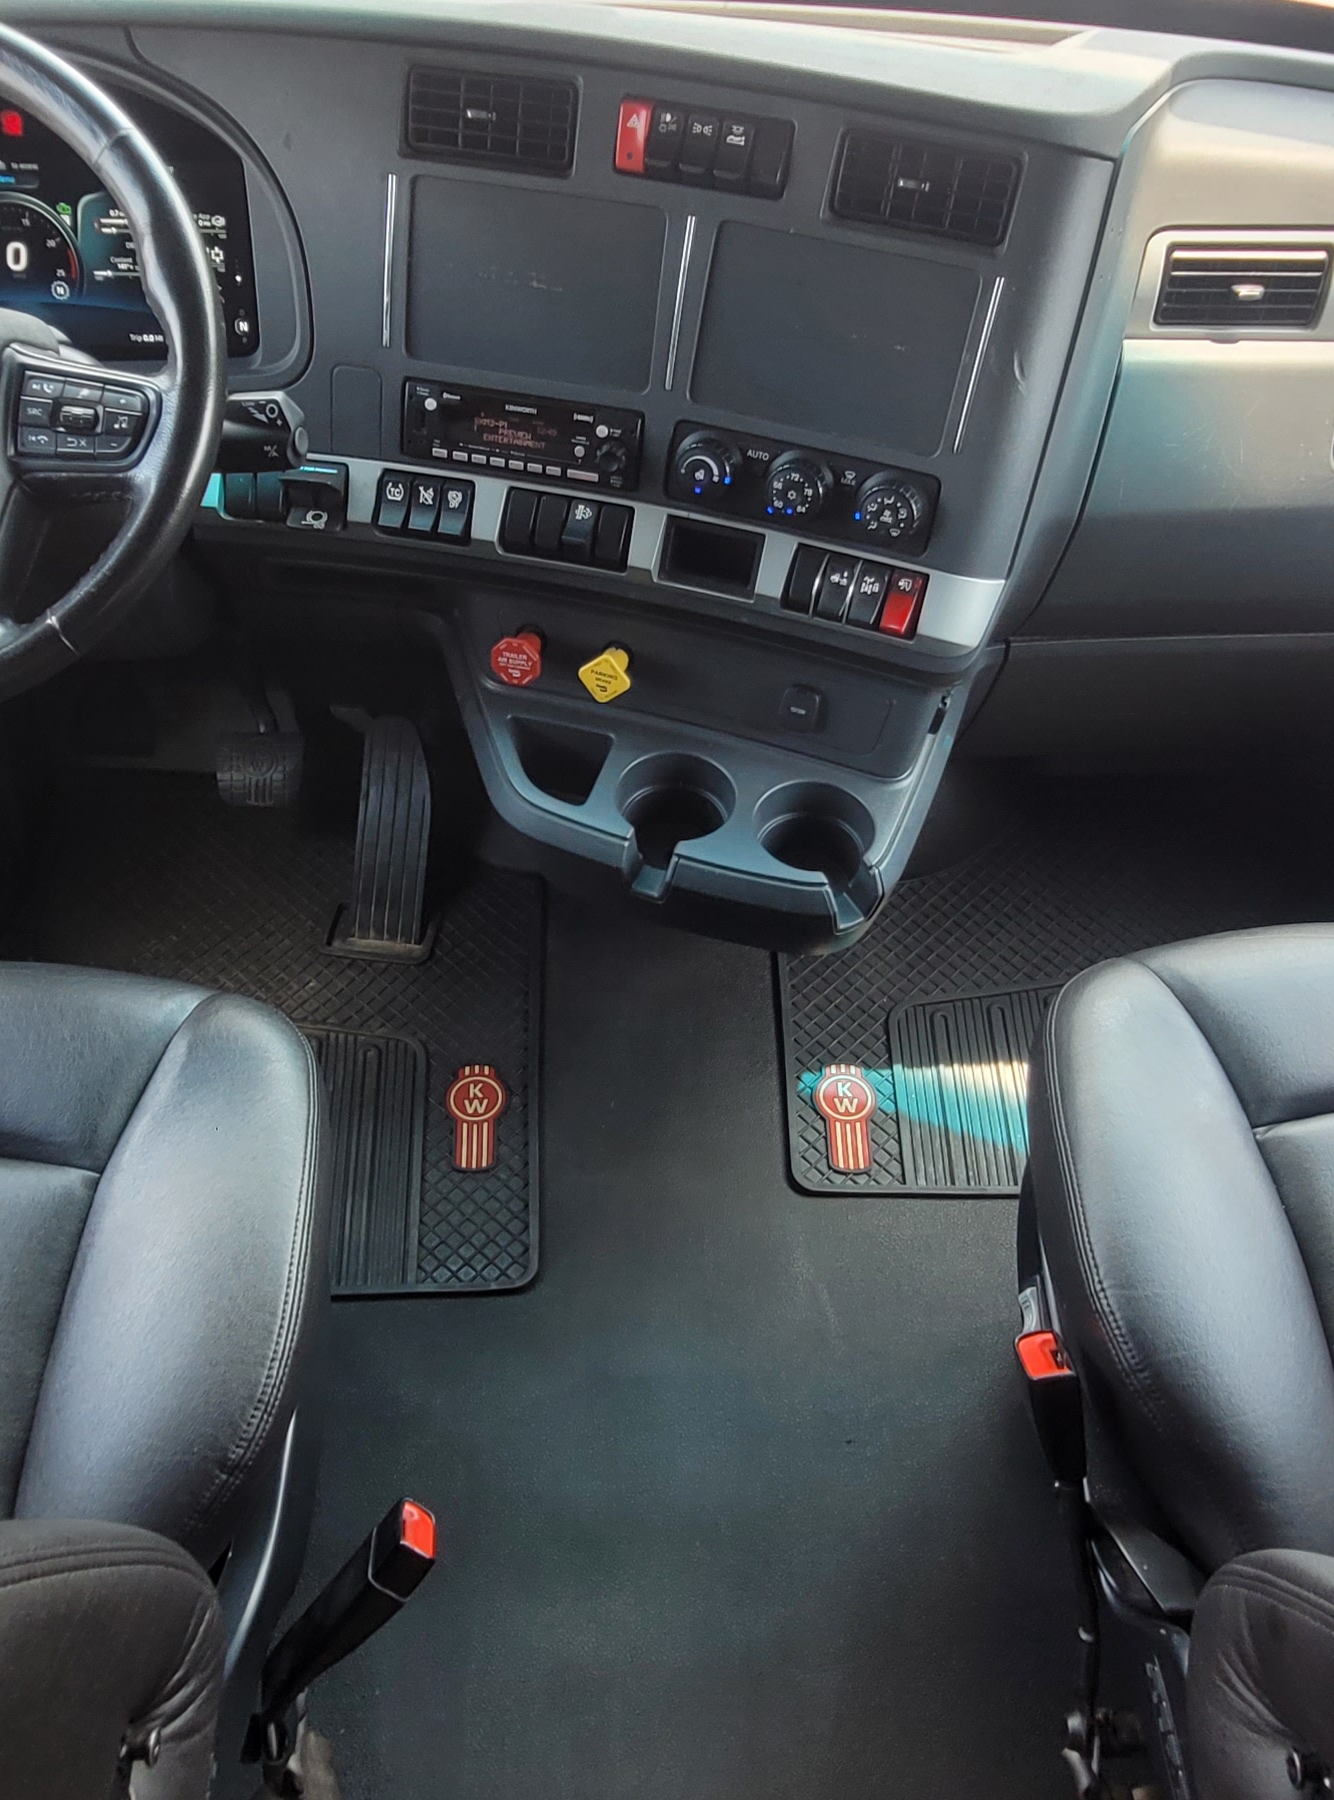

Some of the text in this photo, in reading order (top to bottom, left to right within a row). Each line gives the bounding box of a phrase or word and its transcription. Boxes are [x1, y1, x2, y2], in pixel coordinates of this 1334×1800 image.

[20, 217, 31, 227] 15
[45, 238, 57, 249] 20
[5, 240, 28, 273] 0
[55, 268, 67, 279] 25
[238, 320, 249, 333] N
[128, 333, 143, 343] Trip
[142, 333, 155, 343] 0.0
[26, 406, 43, 417] SRC
[746, 448, 770, 462] AUTO
[790, 471, 800, 482] 72
[390, 487, 402, 497] TC
[497, 656, 508, 664] AIR
[508, 658, 533, 668] SUPPLY
[502, 651, 528, 661] TRAILER
[590, 669, 618, 681] PARKING
[469, 1082, 484, 1098] K
[836, 1081, 853, 1097] K
[463, 1098, 489, 1114] W
[833, 1097, 859, 1114] W
